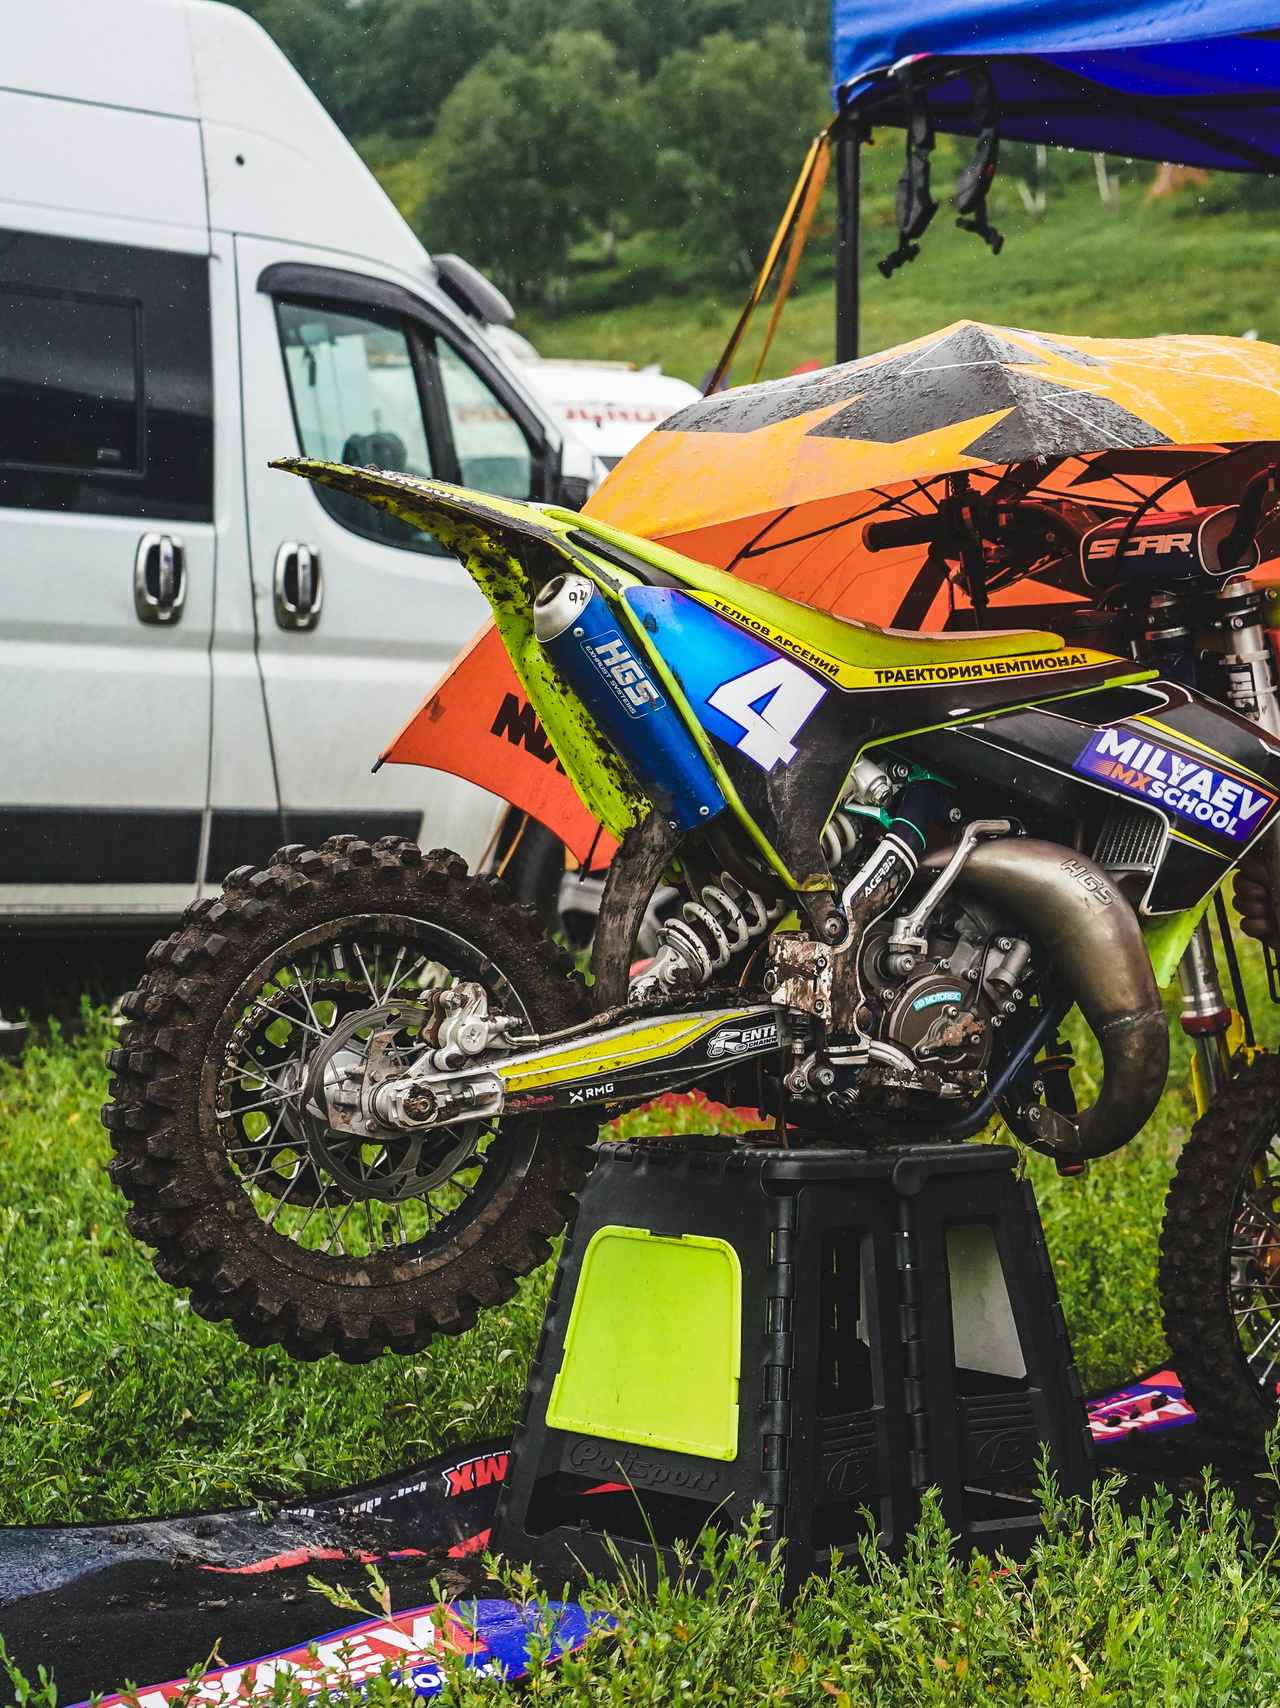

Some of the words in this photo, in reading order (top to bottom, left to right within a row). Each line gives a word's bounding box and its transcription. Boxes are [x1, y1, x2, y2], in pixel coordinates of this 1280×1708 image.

[1087, 533, 1193, 560] SCAR
[594, 638, 660, 707] HGS
[713, 599, 771, 636] ТЕЛКОВ
[773, 634, 841, 678] АРСЕНИЙ
[585, 645, 613, 679] EXHAUST
[609, 679, 638, 715] SYSTEMS
[705, 656, 830, 774] 4
[1095, 727, 1269, 822] MILYAEV
[1110, 763, 1153, 793] MX
[1147, 779, 1239, 836] SCHOOL
[1060, 859, 1120, 907] HGS
[924, 992, 961, 1005] MOTOREX
[585, 1082, 615, 1099] RMG
[571, 1438, 719, 1492] Polisport
